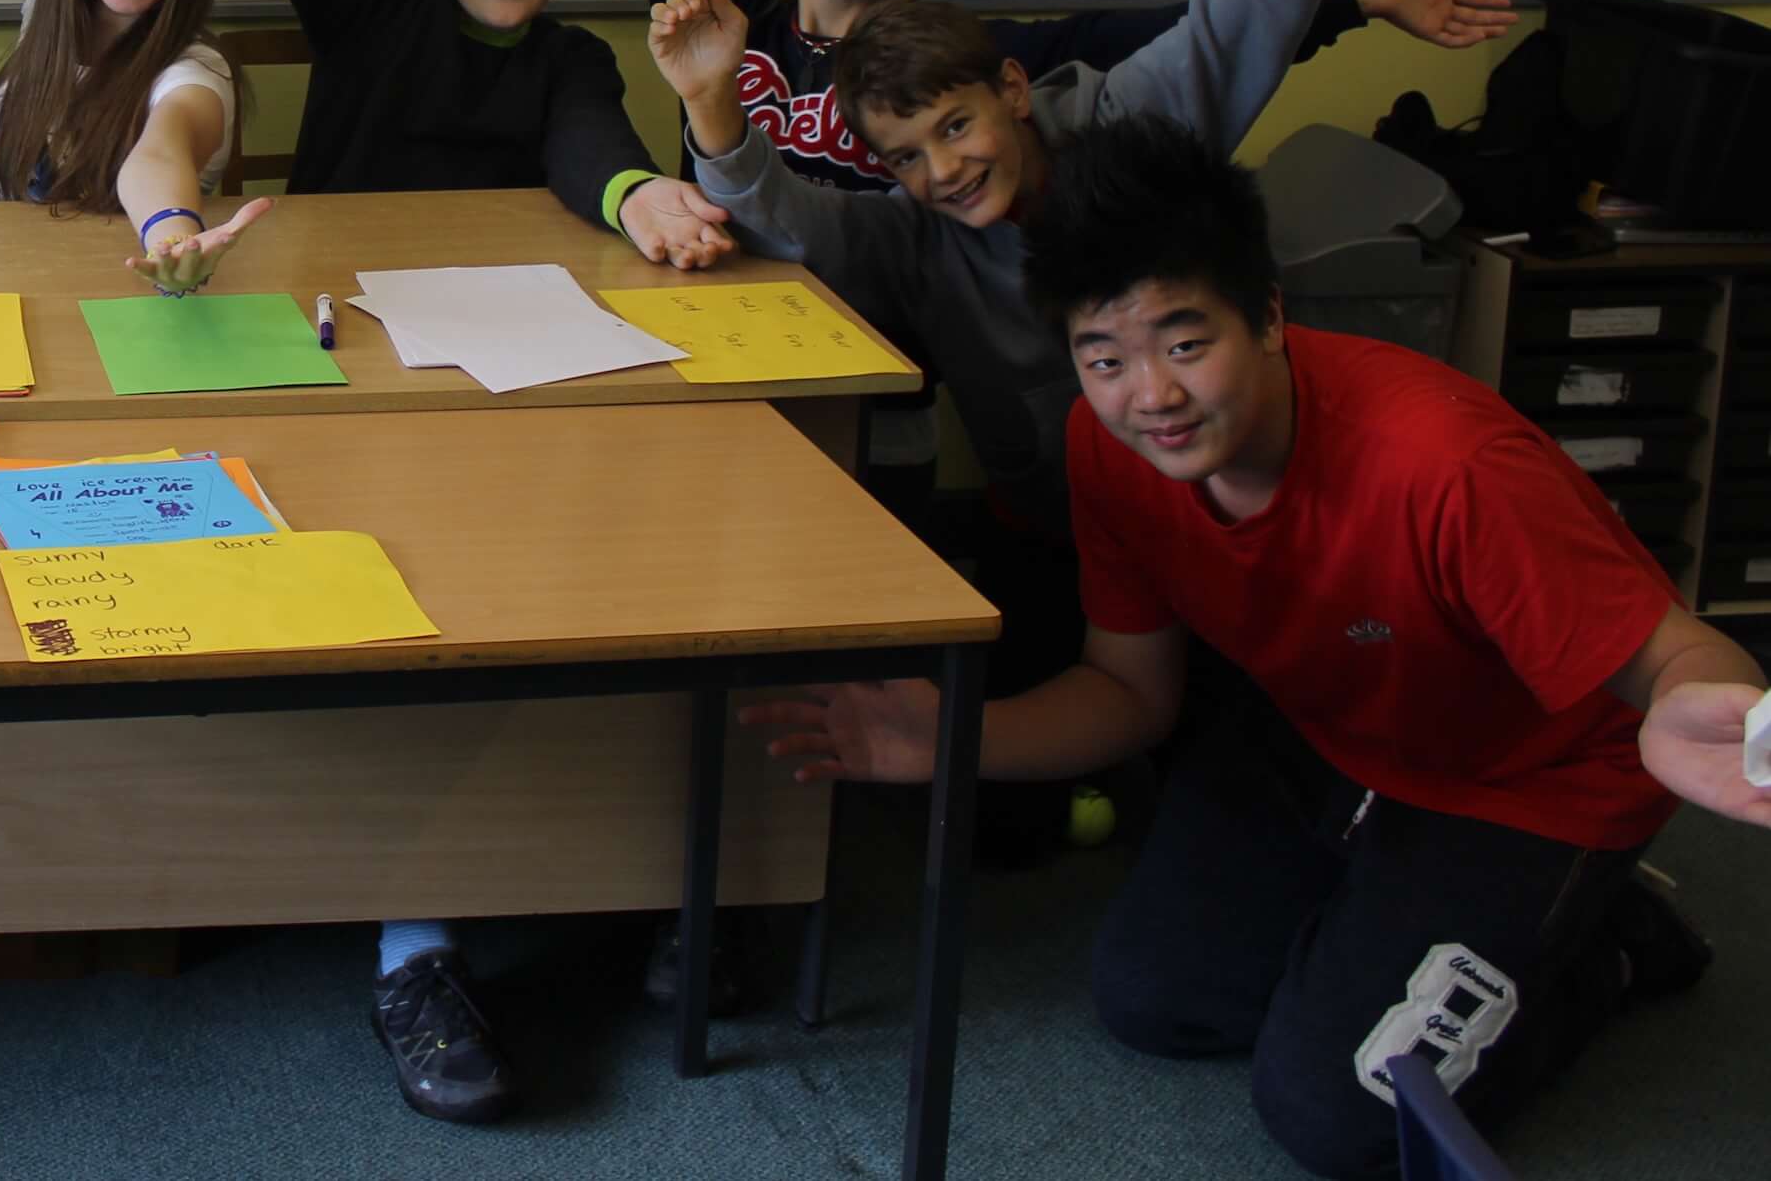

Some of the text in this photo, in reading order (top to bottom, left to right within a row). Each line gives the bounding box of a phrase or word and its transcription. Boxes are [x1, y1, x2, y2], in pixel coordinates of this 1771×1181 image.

[16, 482, 62, 492] Love
[82, 478, 105, 487] ice
[115, 476, 169, 484] cream
[30, 482, 194, 502] All About Me
[213, 538, 281, 550] dark
[32, 593, 117, 610] rainy
[99, 643, 192, 655] bright
